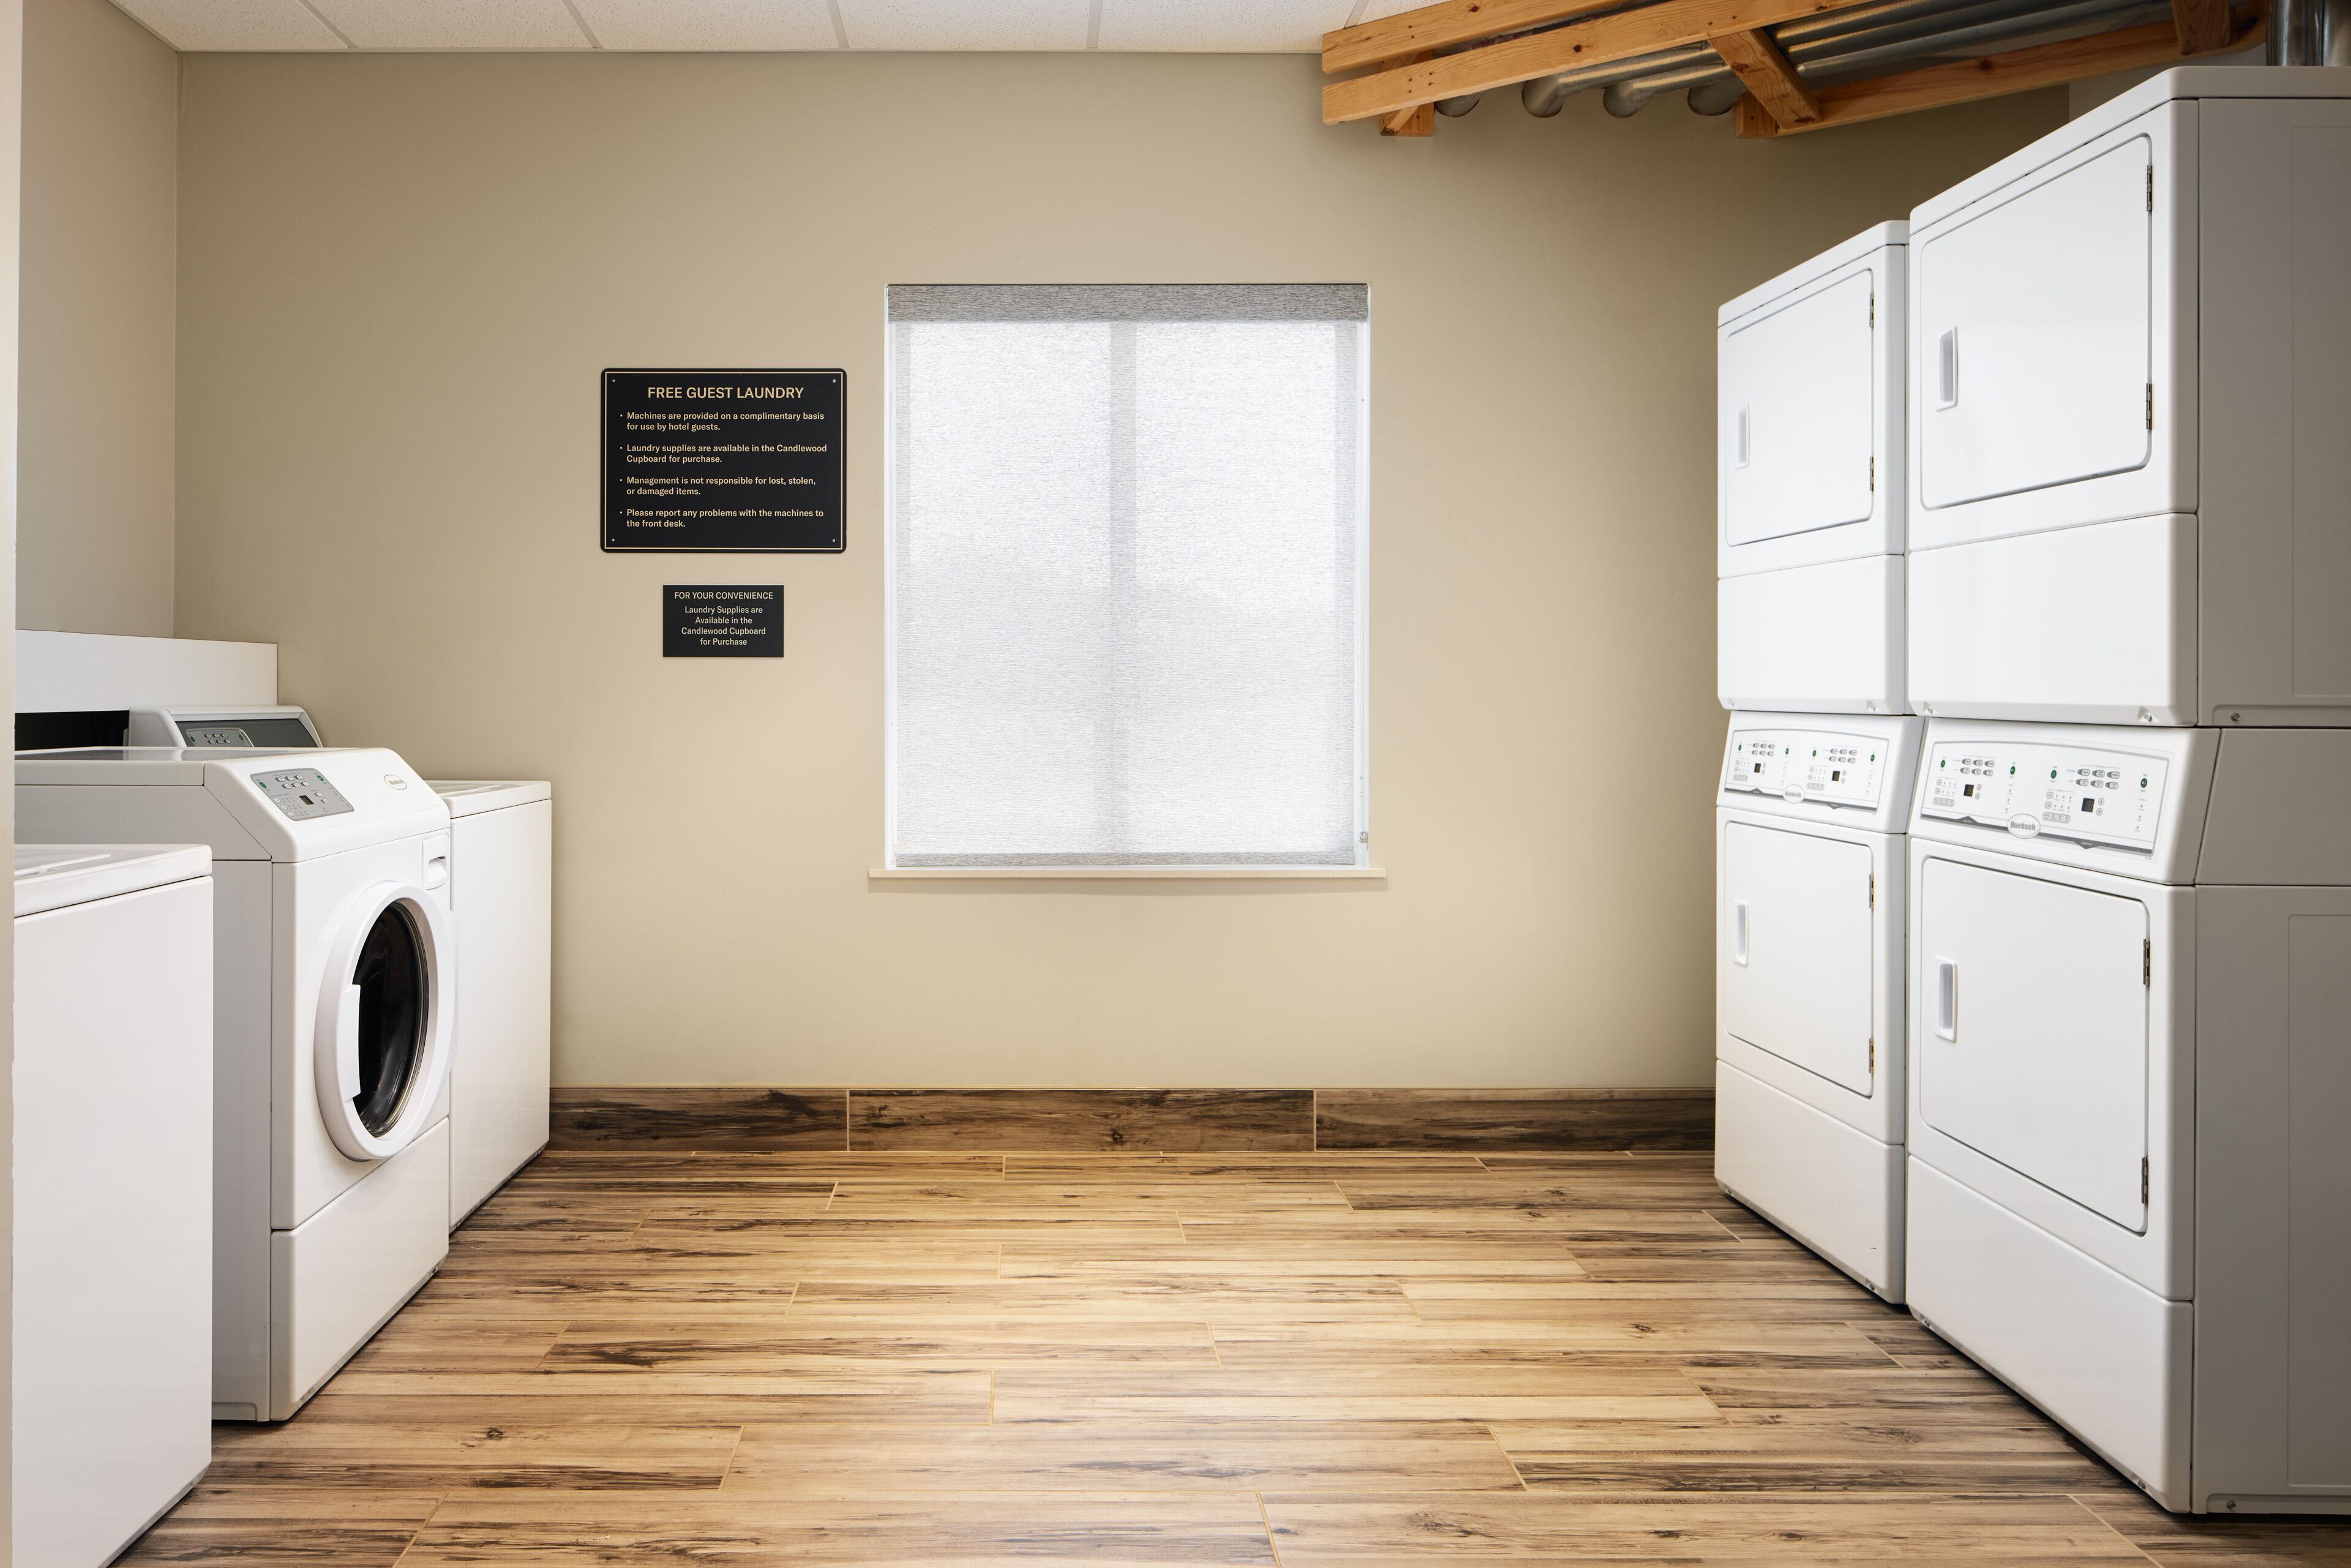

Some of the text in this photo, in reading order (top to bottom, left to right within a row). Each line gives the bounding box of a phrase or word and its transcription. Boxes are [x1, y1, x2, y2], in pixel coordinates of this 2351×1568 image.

[648, 387, 804, 399] FREE GUEST LAUNDRY
[683, 411, 719, 421] provided
[740, 411, 801, 421] complimentary
[803, 411, 825, 420] basis
[657, 422, 667, 432] by
[691, 423, 721, 432] guests.
[627, 444, 660, 454] Laundry
[662, 444, 696, 454] supplies
[776, 444, 827, 452] Candlewood
[626, 454, 722, 464] Cupboard for purchase.
[627, 476, 680, 486] Management
[706, 476, 753, 486] responsible
[768, 476, 786, 486] lost,
[788, 476, 816, 486] stolen,
[637, 487, 674, 497] damaged
[626, 508, 654, 517] Please
[656, 509, 681, 518] report
[699, 509, 737, 518] problems
[684, 606, 716, 615] Laundry
[716, 606, 749, 615] Supplies
[729, 627, 766, 637] Cupboard
[2009, 821, 2036, 831] Huebsch
